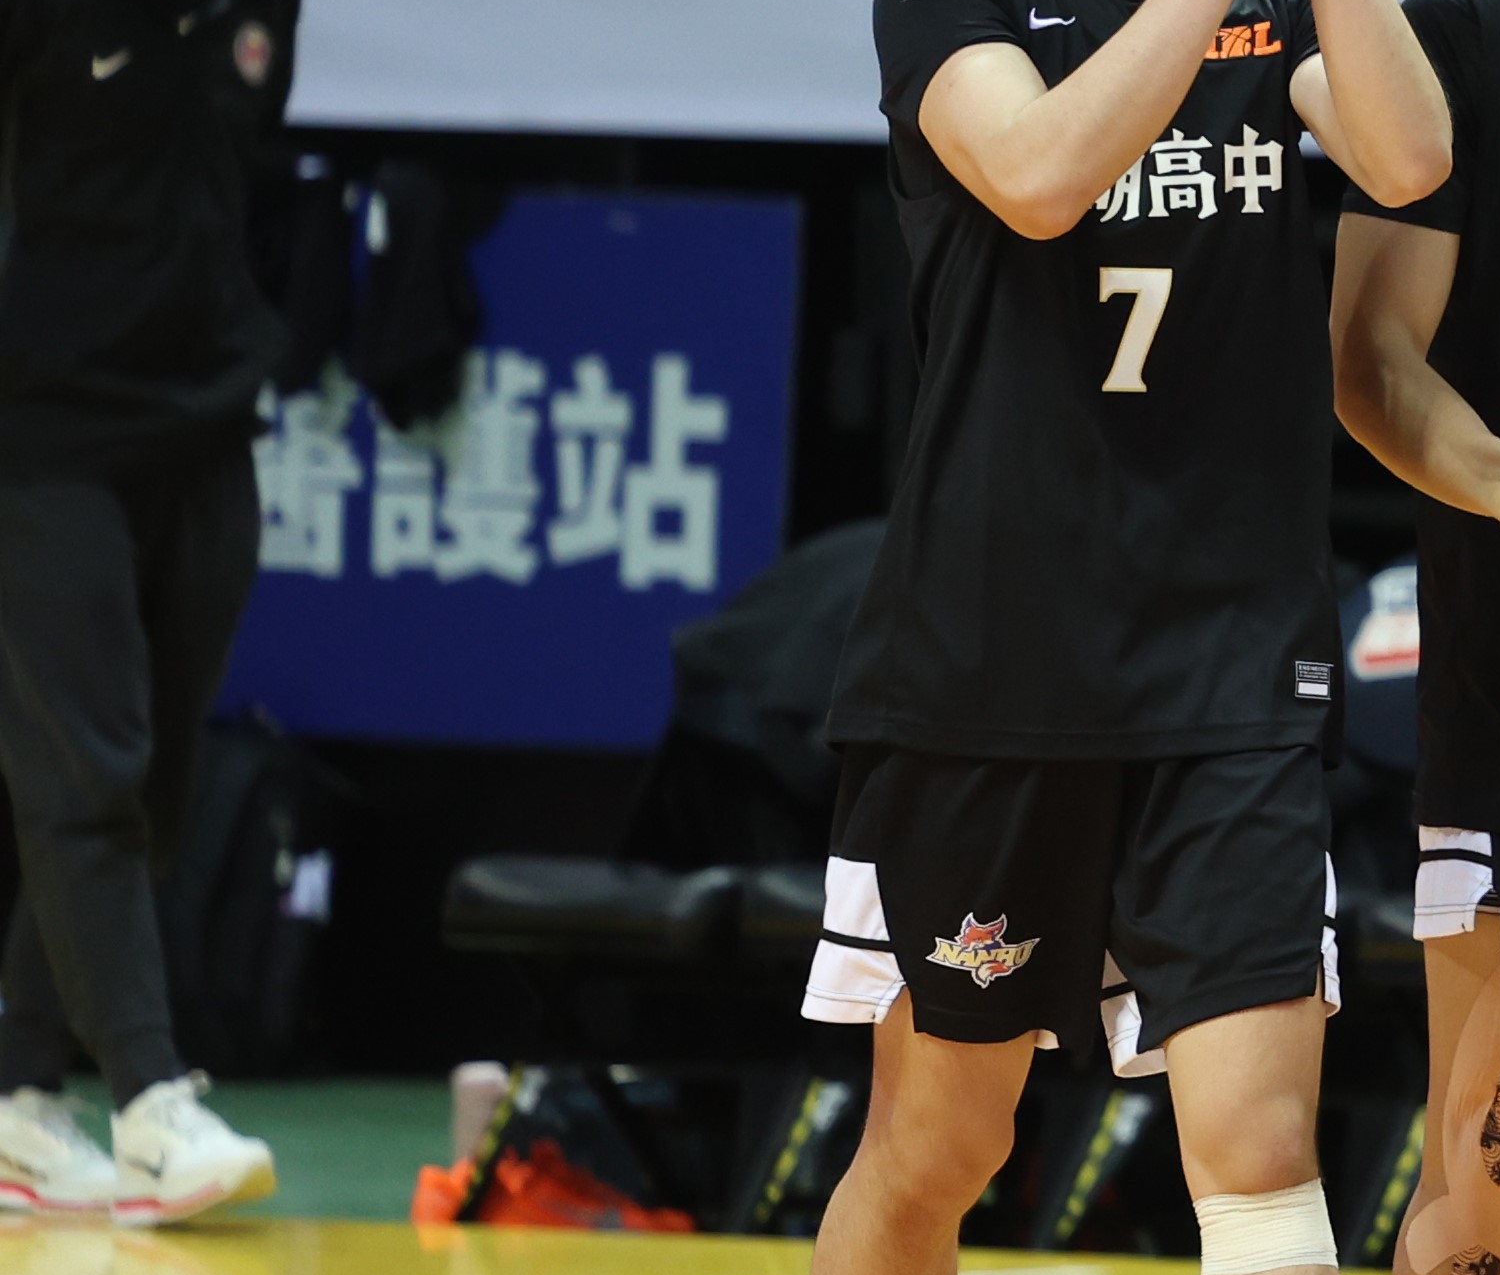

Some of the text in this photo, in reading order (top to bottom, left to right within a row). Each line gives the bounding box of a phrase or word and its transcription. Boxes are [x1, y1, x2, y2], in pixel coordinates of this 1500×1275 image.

[1089, 124, 1284, 223] 高中
[1100, 267, 1173, 392] 7
[933, 941, 1036, 969] NANHU
